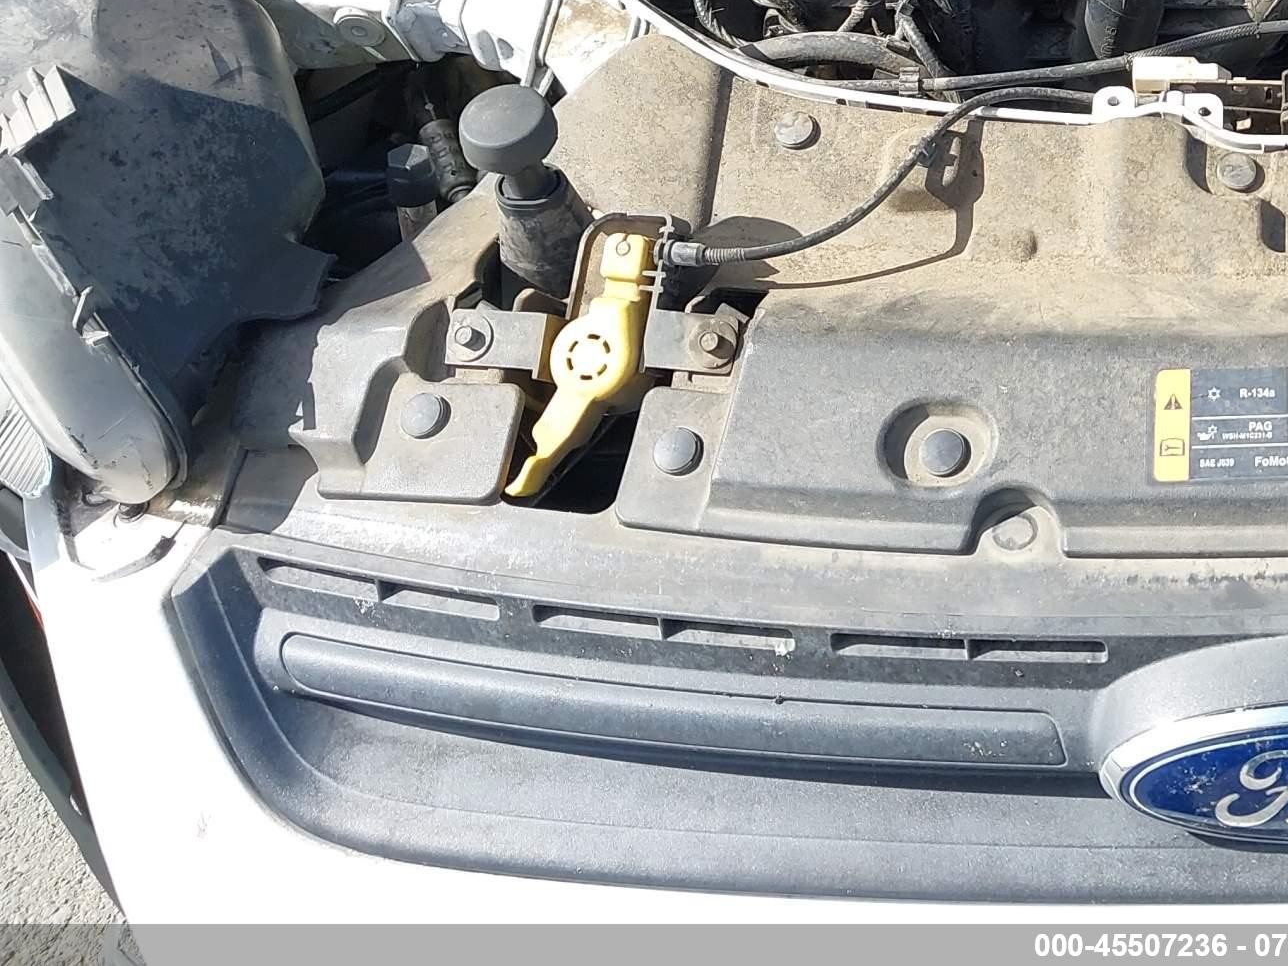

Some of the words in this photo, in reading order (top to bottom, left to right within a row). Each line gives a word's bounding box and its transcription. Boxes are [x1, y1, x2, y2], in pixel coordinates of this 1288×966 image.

[1239, 387, 1276, 399] R-134a
[1248, 421, 1273, 432] PAG
[1199, 458, 1215, 468] SAE
